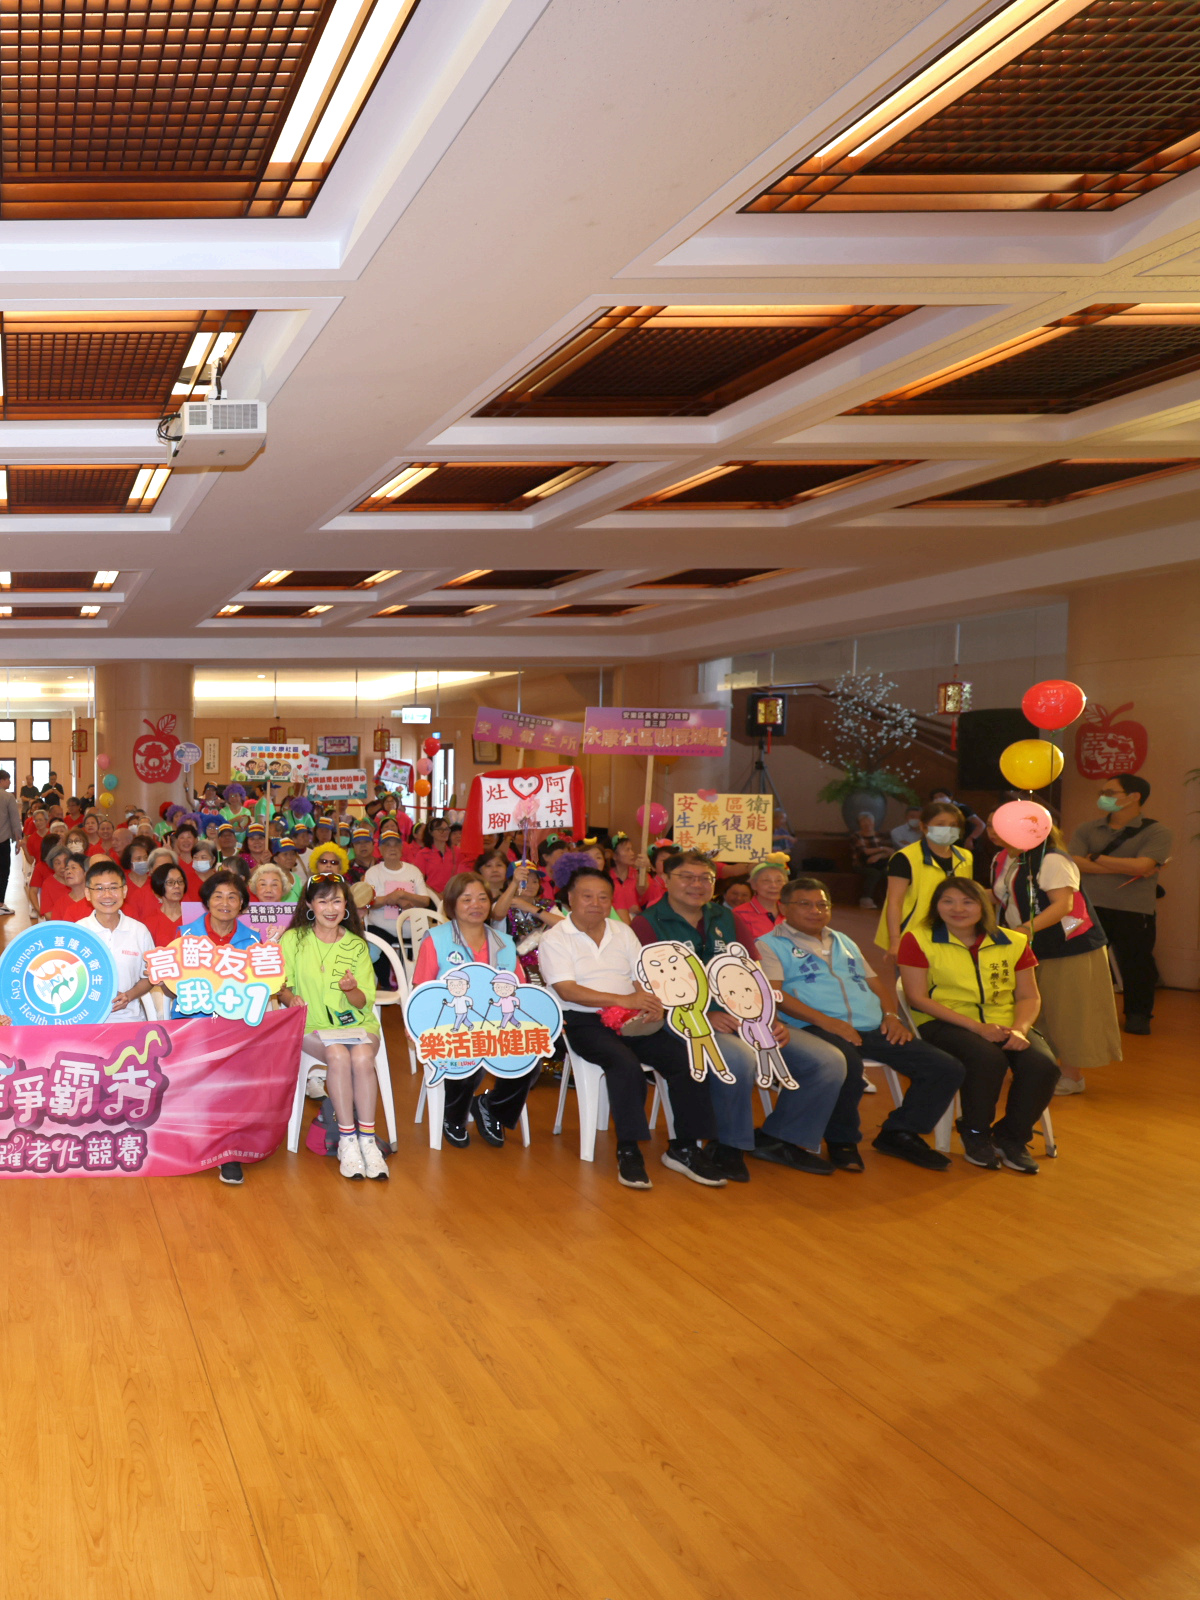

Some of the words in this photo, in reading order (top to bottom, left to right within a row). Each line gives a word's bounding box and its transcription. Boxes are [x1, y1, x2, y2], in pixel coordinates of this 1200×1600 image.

[476, 720, 578, 751] 安樂衛生所
[545, 819, 564, 828] 113
[245, 905, 297, 915] 長者活力競
[250, 914, 278, 924] 第四隊
[10, 939, 45, 974] Keelung
[54, 935, 103, 1002] 基隆市衛生局
[145, 938, 283, 980] 高齡友善
[10, 979, 22, 1001] City
[178, 981, 270, 1026] 我+1
[18, 1002, 49, 1025] Health
[54, 1008, 90, 1025] Bureau
[419, 1027, 552, 1060] 樂活動健康
